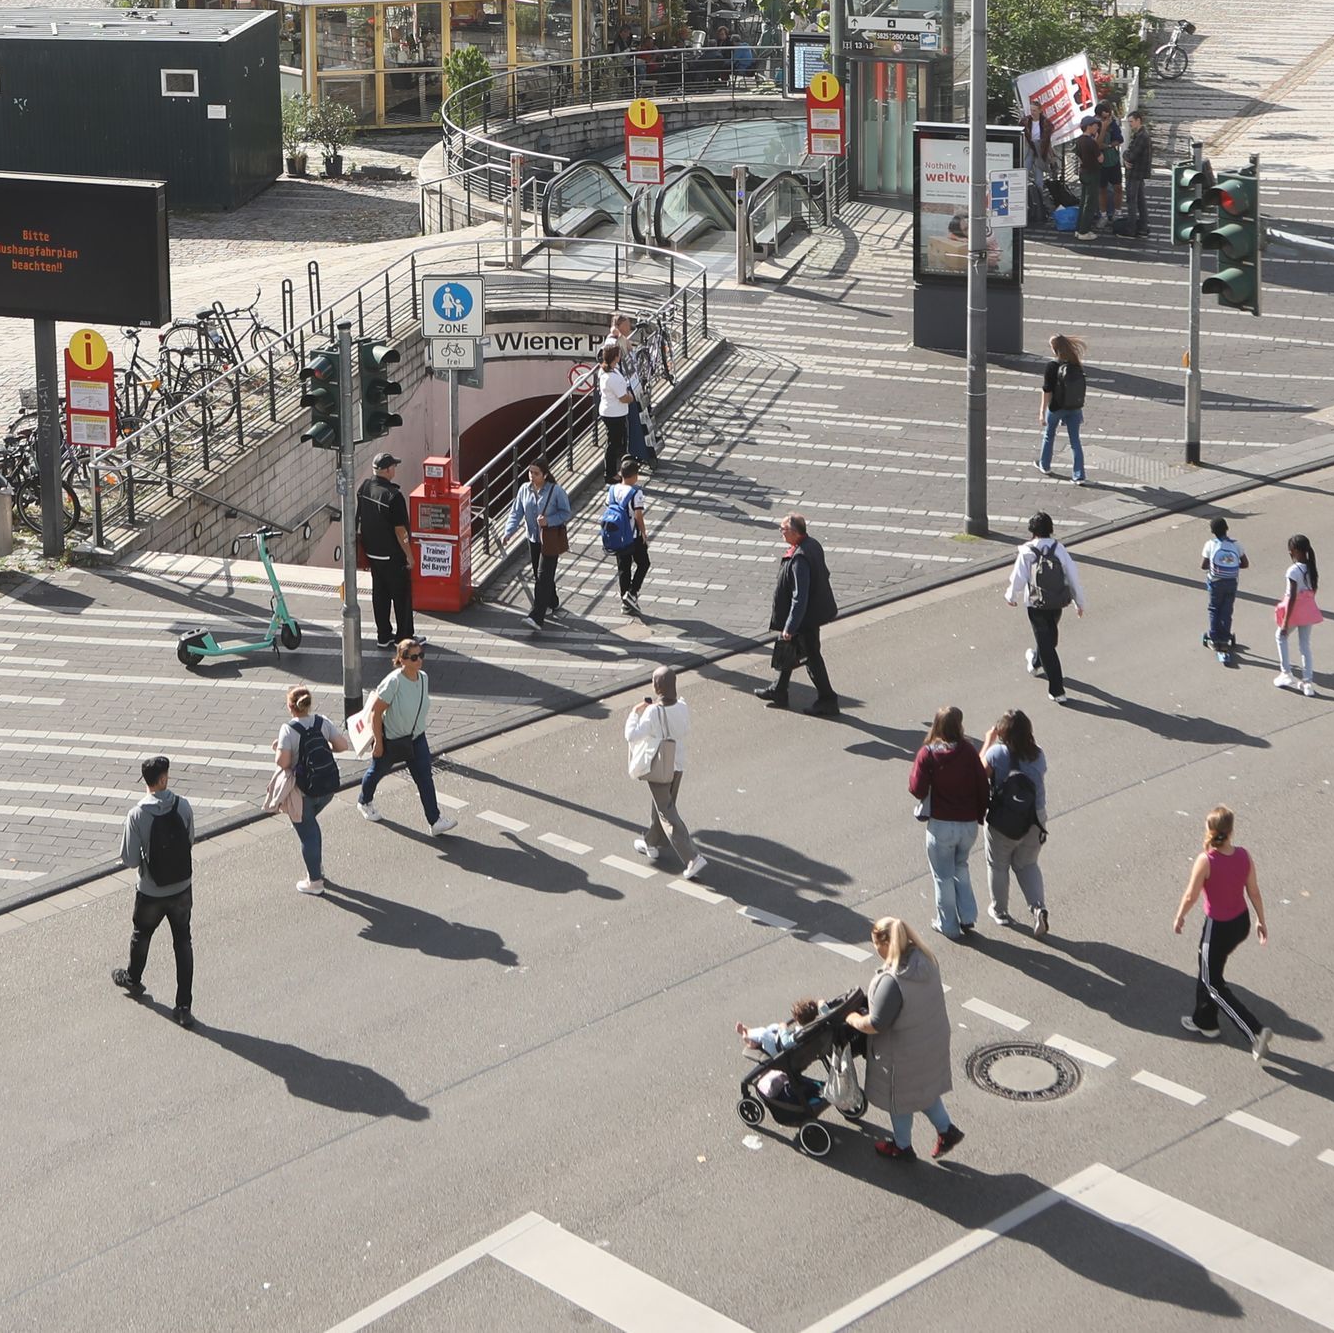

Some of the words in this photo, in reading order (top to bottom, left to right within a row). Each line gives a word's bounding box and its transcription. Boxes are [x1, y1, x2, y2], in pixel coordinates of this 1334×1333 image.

[925, 162, 956, 170] Nothilfe
[22, 230, 50, 241] Bitte
[11, 259, 63, 273] beachten!!
[438, 323, 468, 333] ZONE
[495, 332, 583, 351] Wiener
[447, 358, 461, 366] frei
[426, 546, 448, 555] Trainer-
[423, 556, 450, 565] Rauswurf
[422, 562, 431, 571] bei
[431, 562, 451, 572] Bayer?
